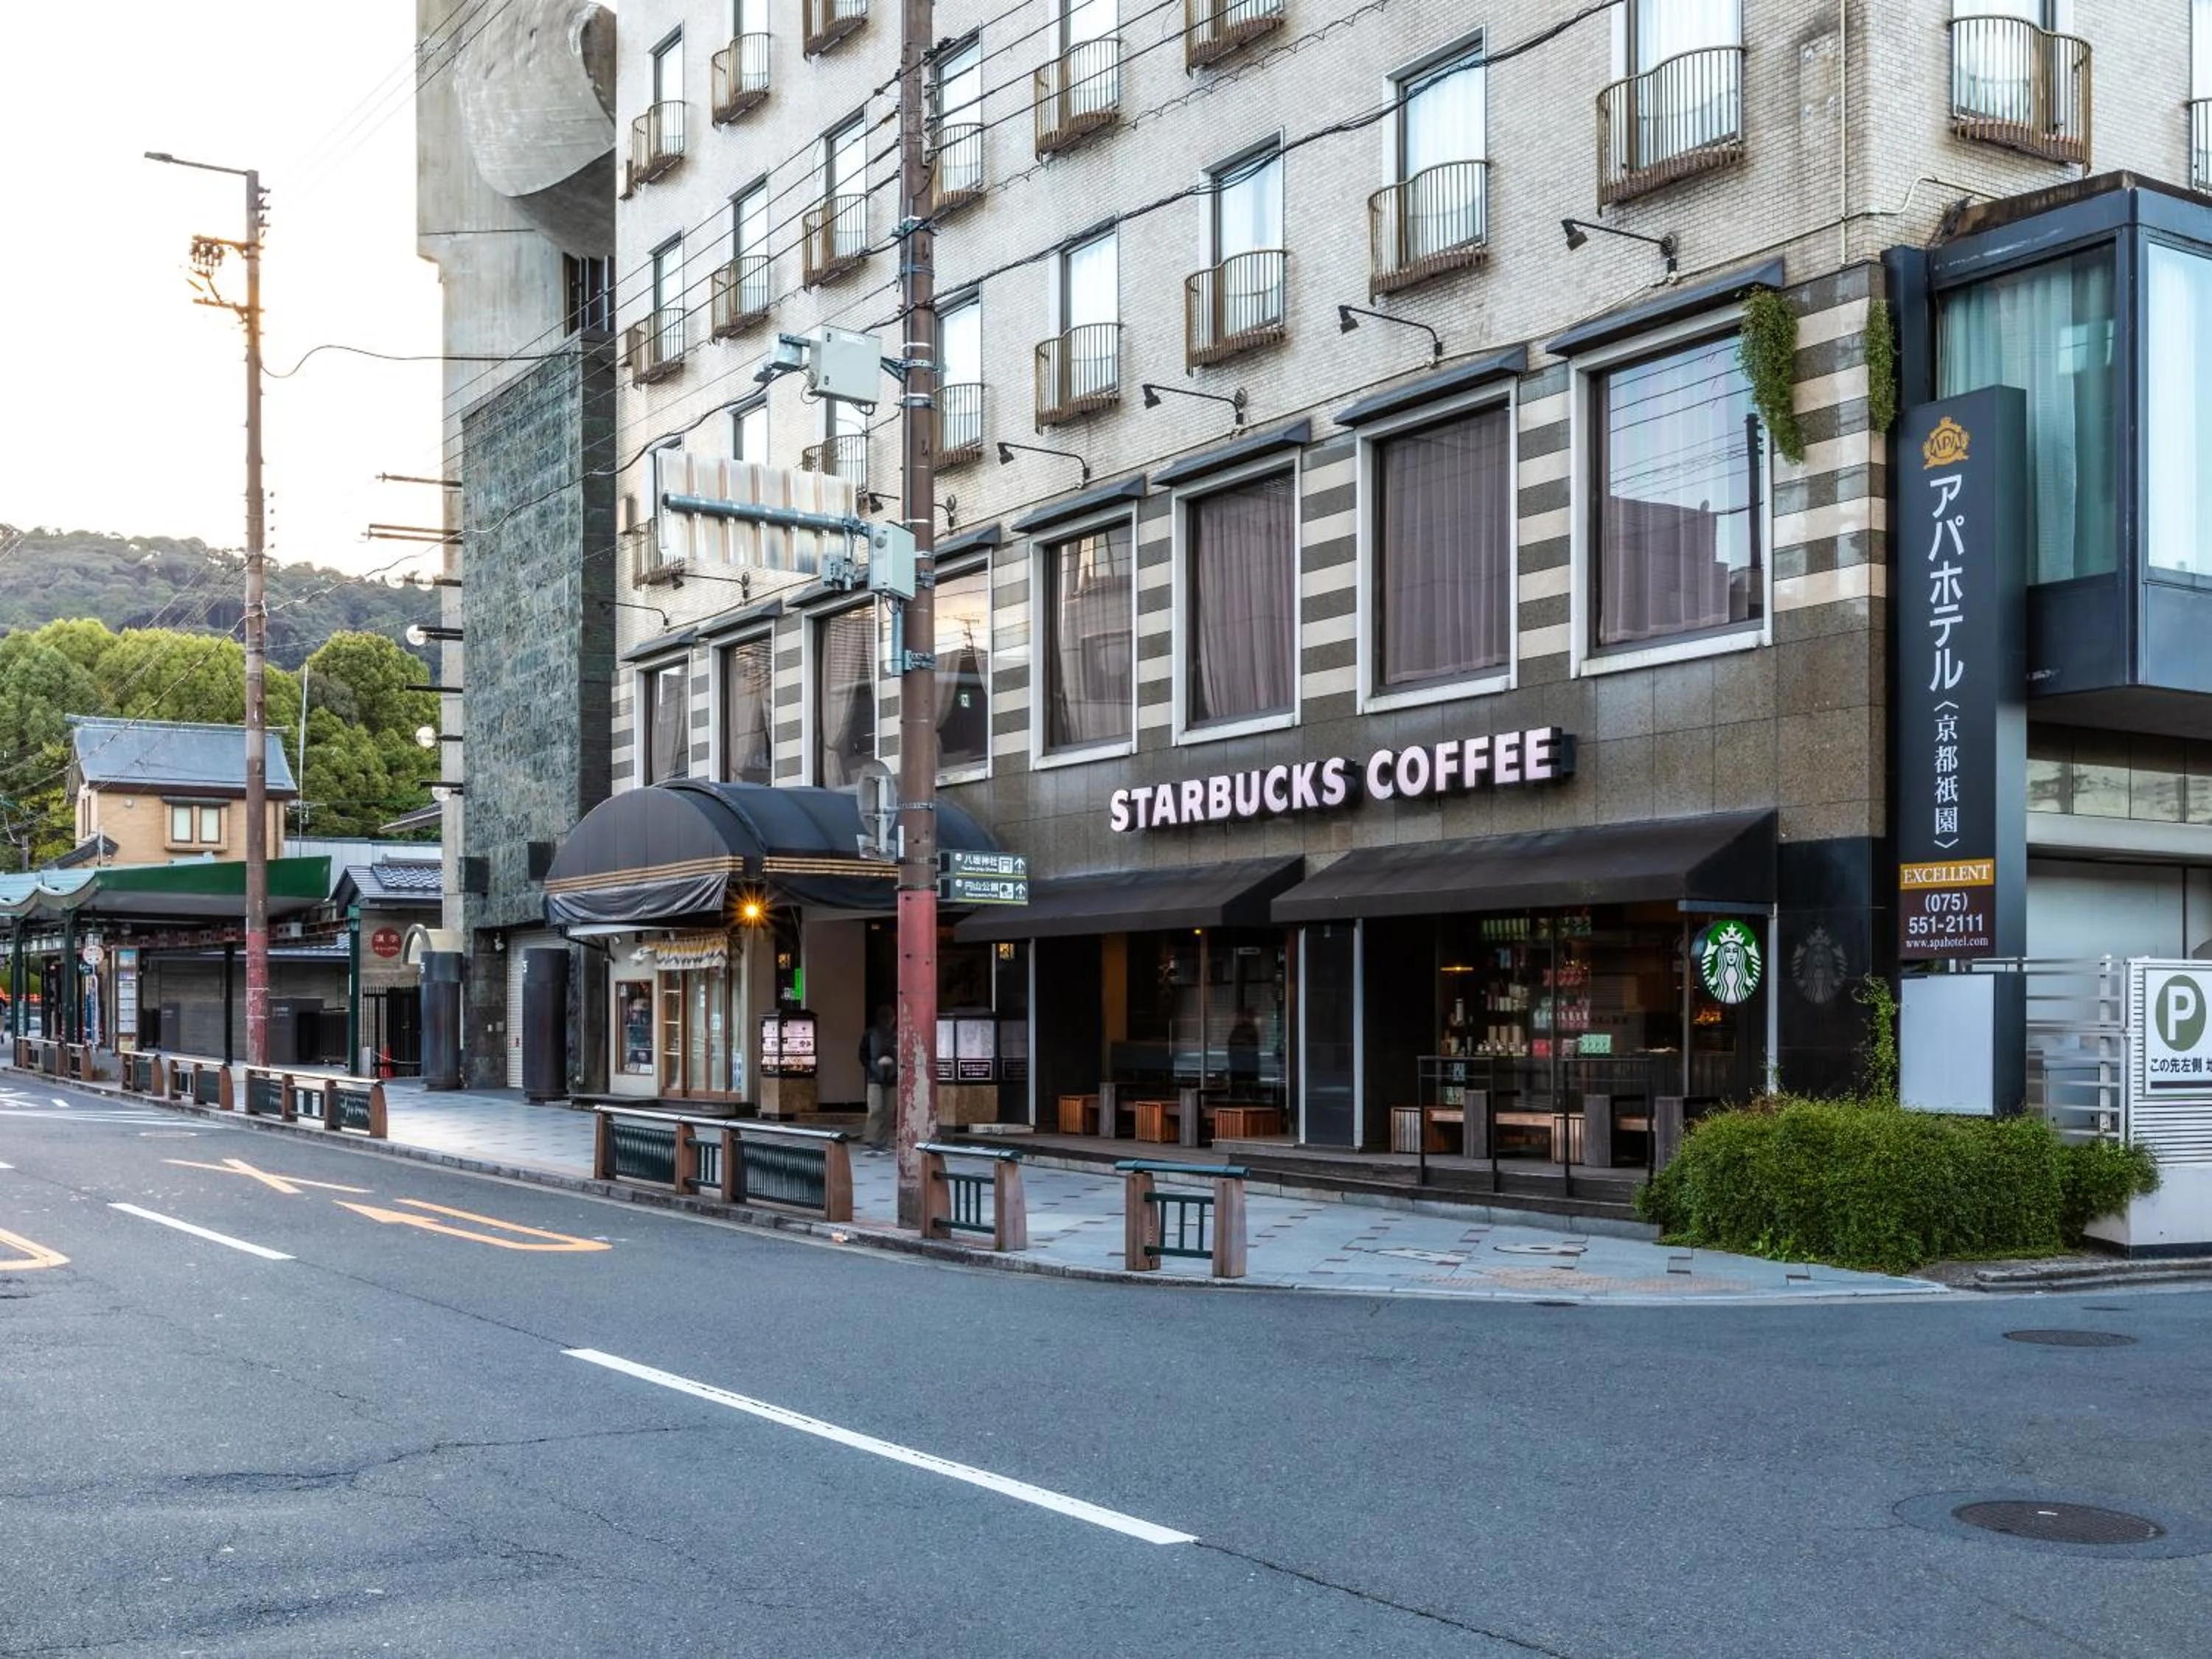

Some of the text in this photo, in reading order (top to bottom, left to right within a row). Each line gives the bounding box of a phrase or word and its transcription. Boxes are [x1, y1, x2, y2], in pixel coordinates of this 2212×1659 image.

[1928, 474, 1965, 692] アパホテル
[1110, 726, 1551, 832] STARBUCKS COFFEE
[1904, 863, 1990, 884] EXCELLENT
[1925, 892, 1968, 913] (075)
[1908, 914, 1983, 935] 551-2111
[1905, 935, 1989, 950] www.apahotel.com
[2167, 986, 2197, 1041] P
[2150, 1057, 2202, 1073] この先左側
